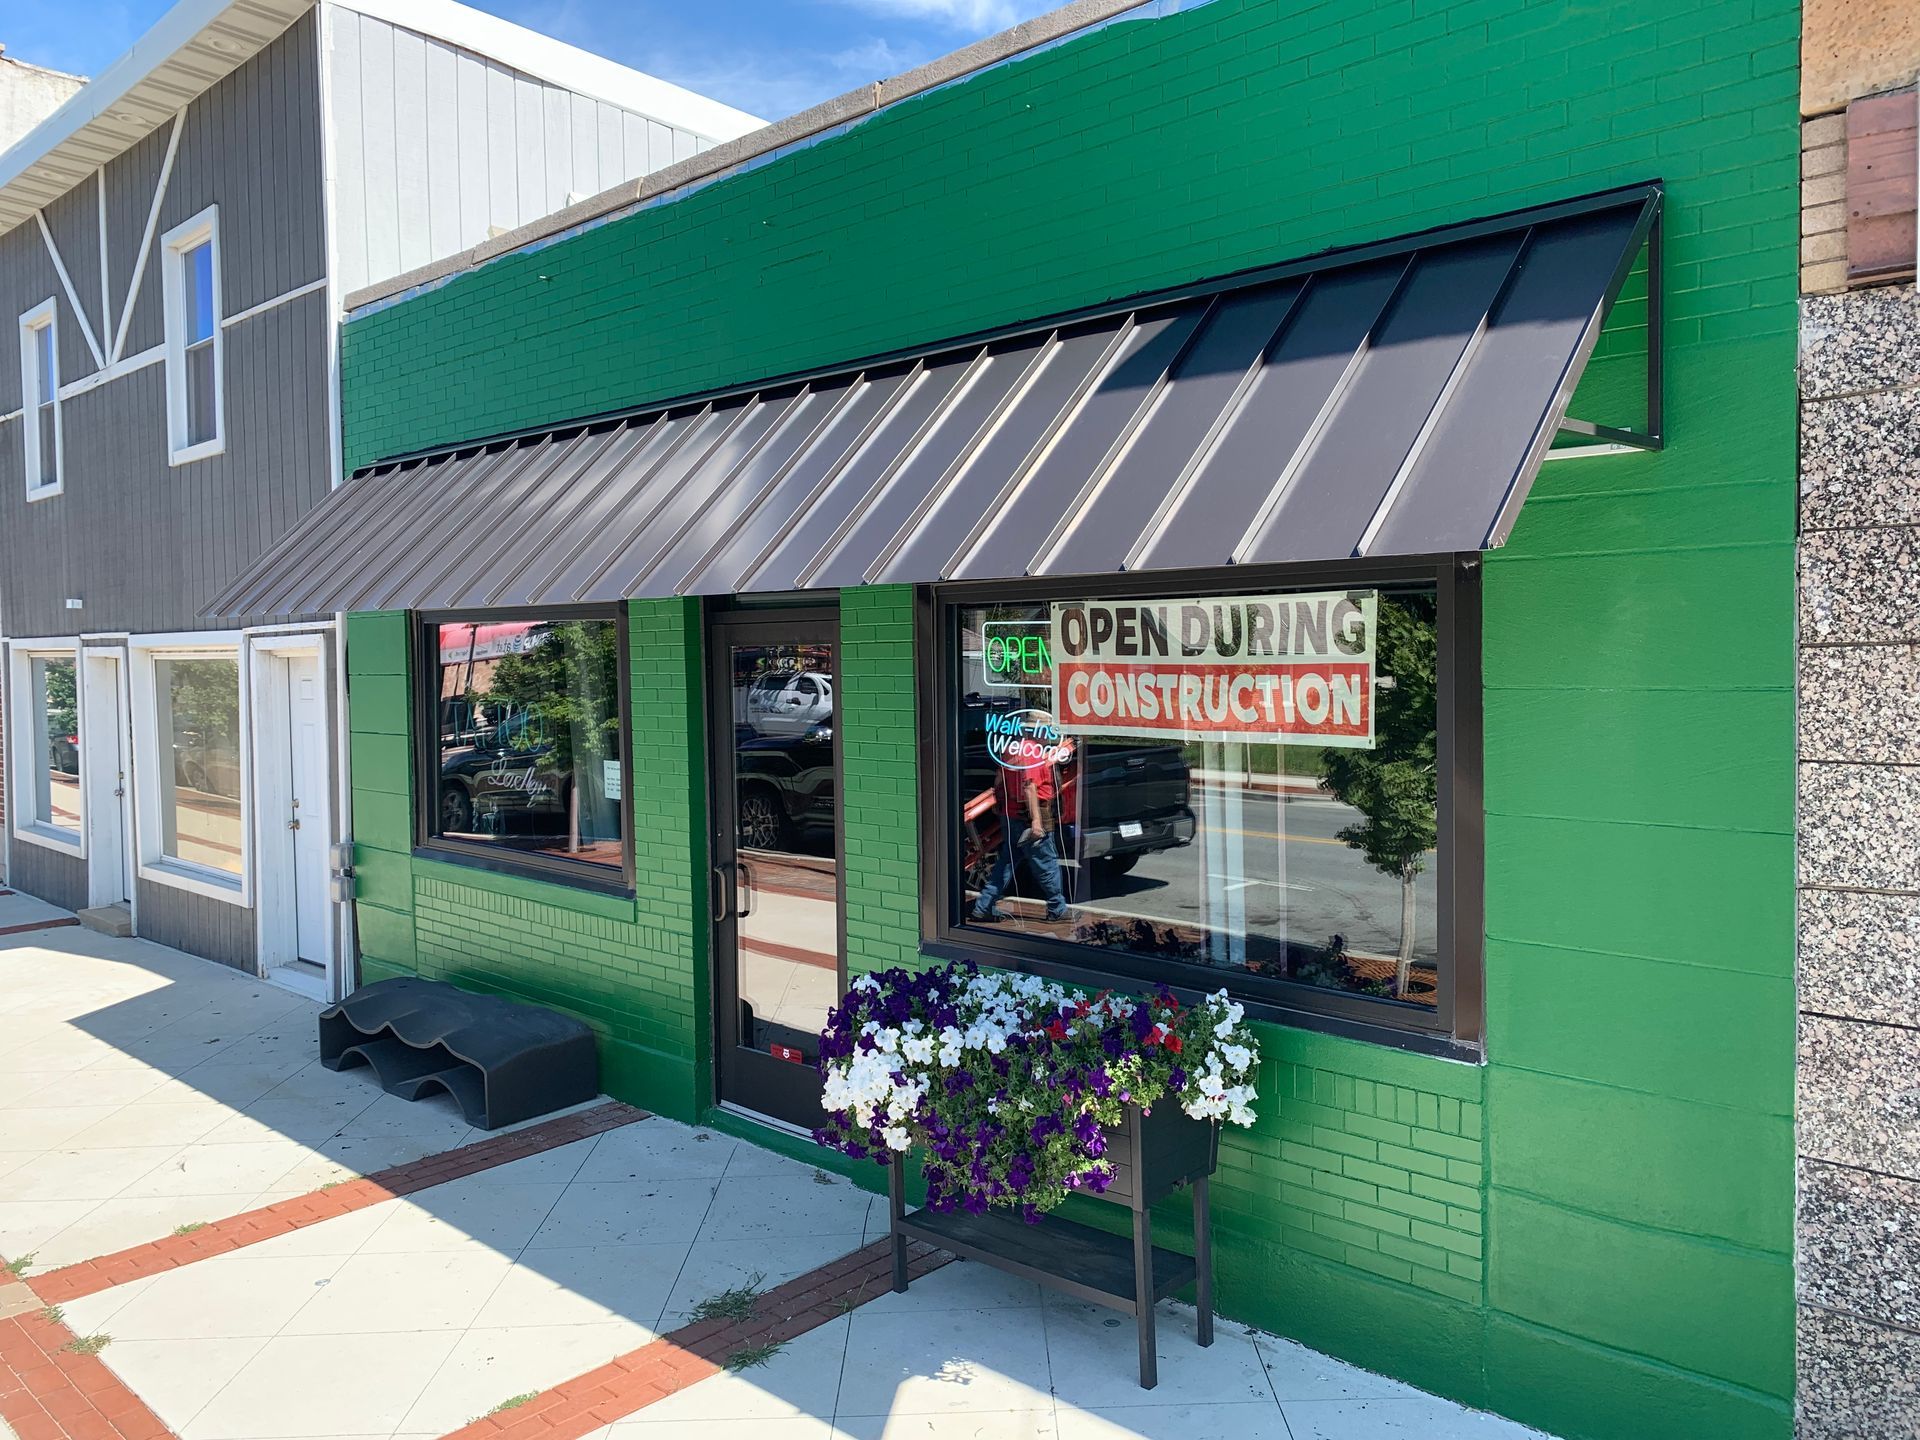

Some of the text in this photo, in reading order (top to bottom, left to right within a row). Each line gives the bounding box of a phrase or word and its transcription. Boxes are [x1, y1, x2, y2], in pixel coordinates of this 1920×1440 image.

[1061, 599, 1367, 657] OPEN DURING
[987, 636, 1053, 673] OPEN
[1067, 670, 1361, 726] CONSTRUCTION
[993, 733, 1070, 763] Welcome
